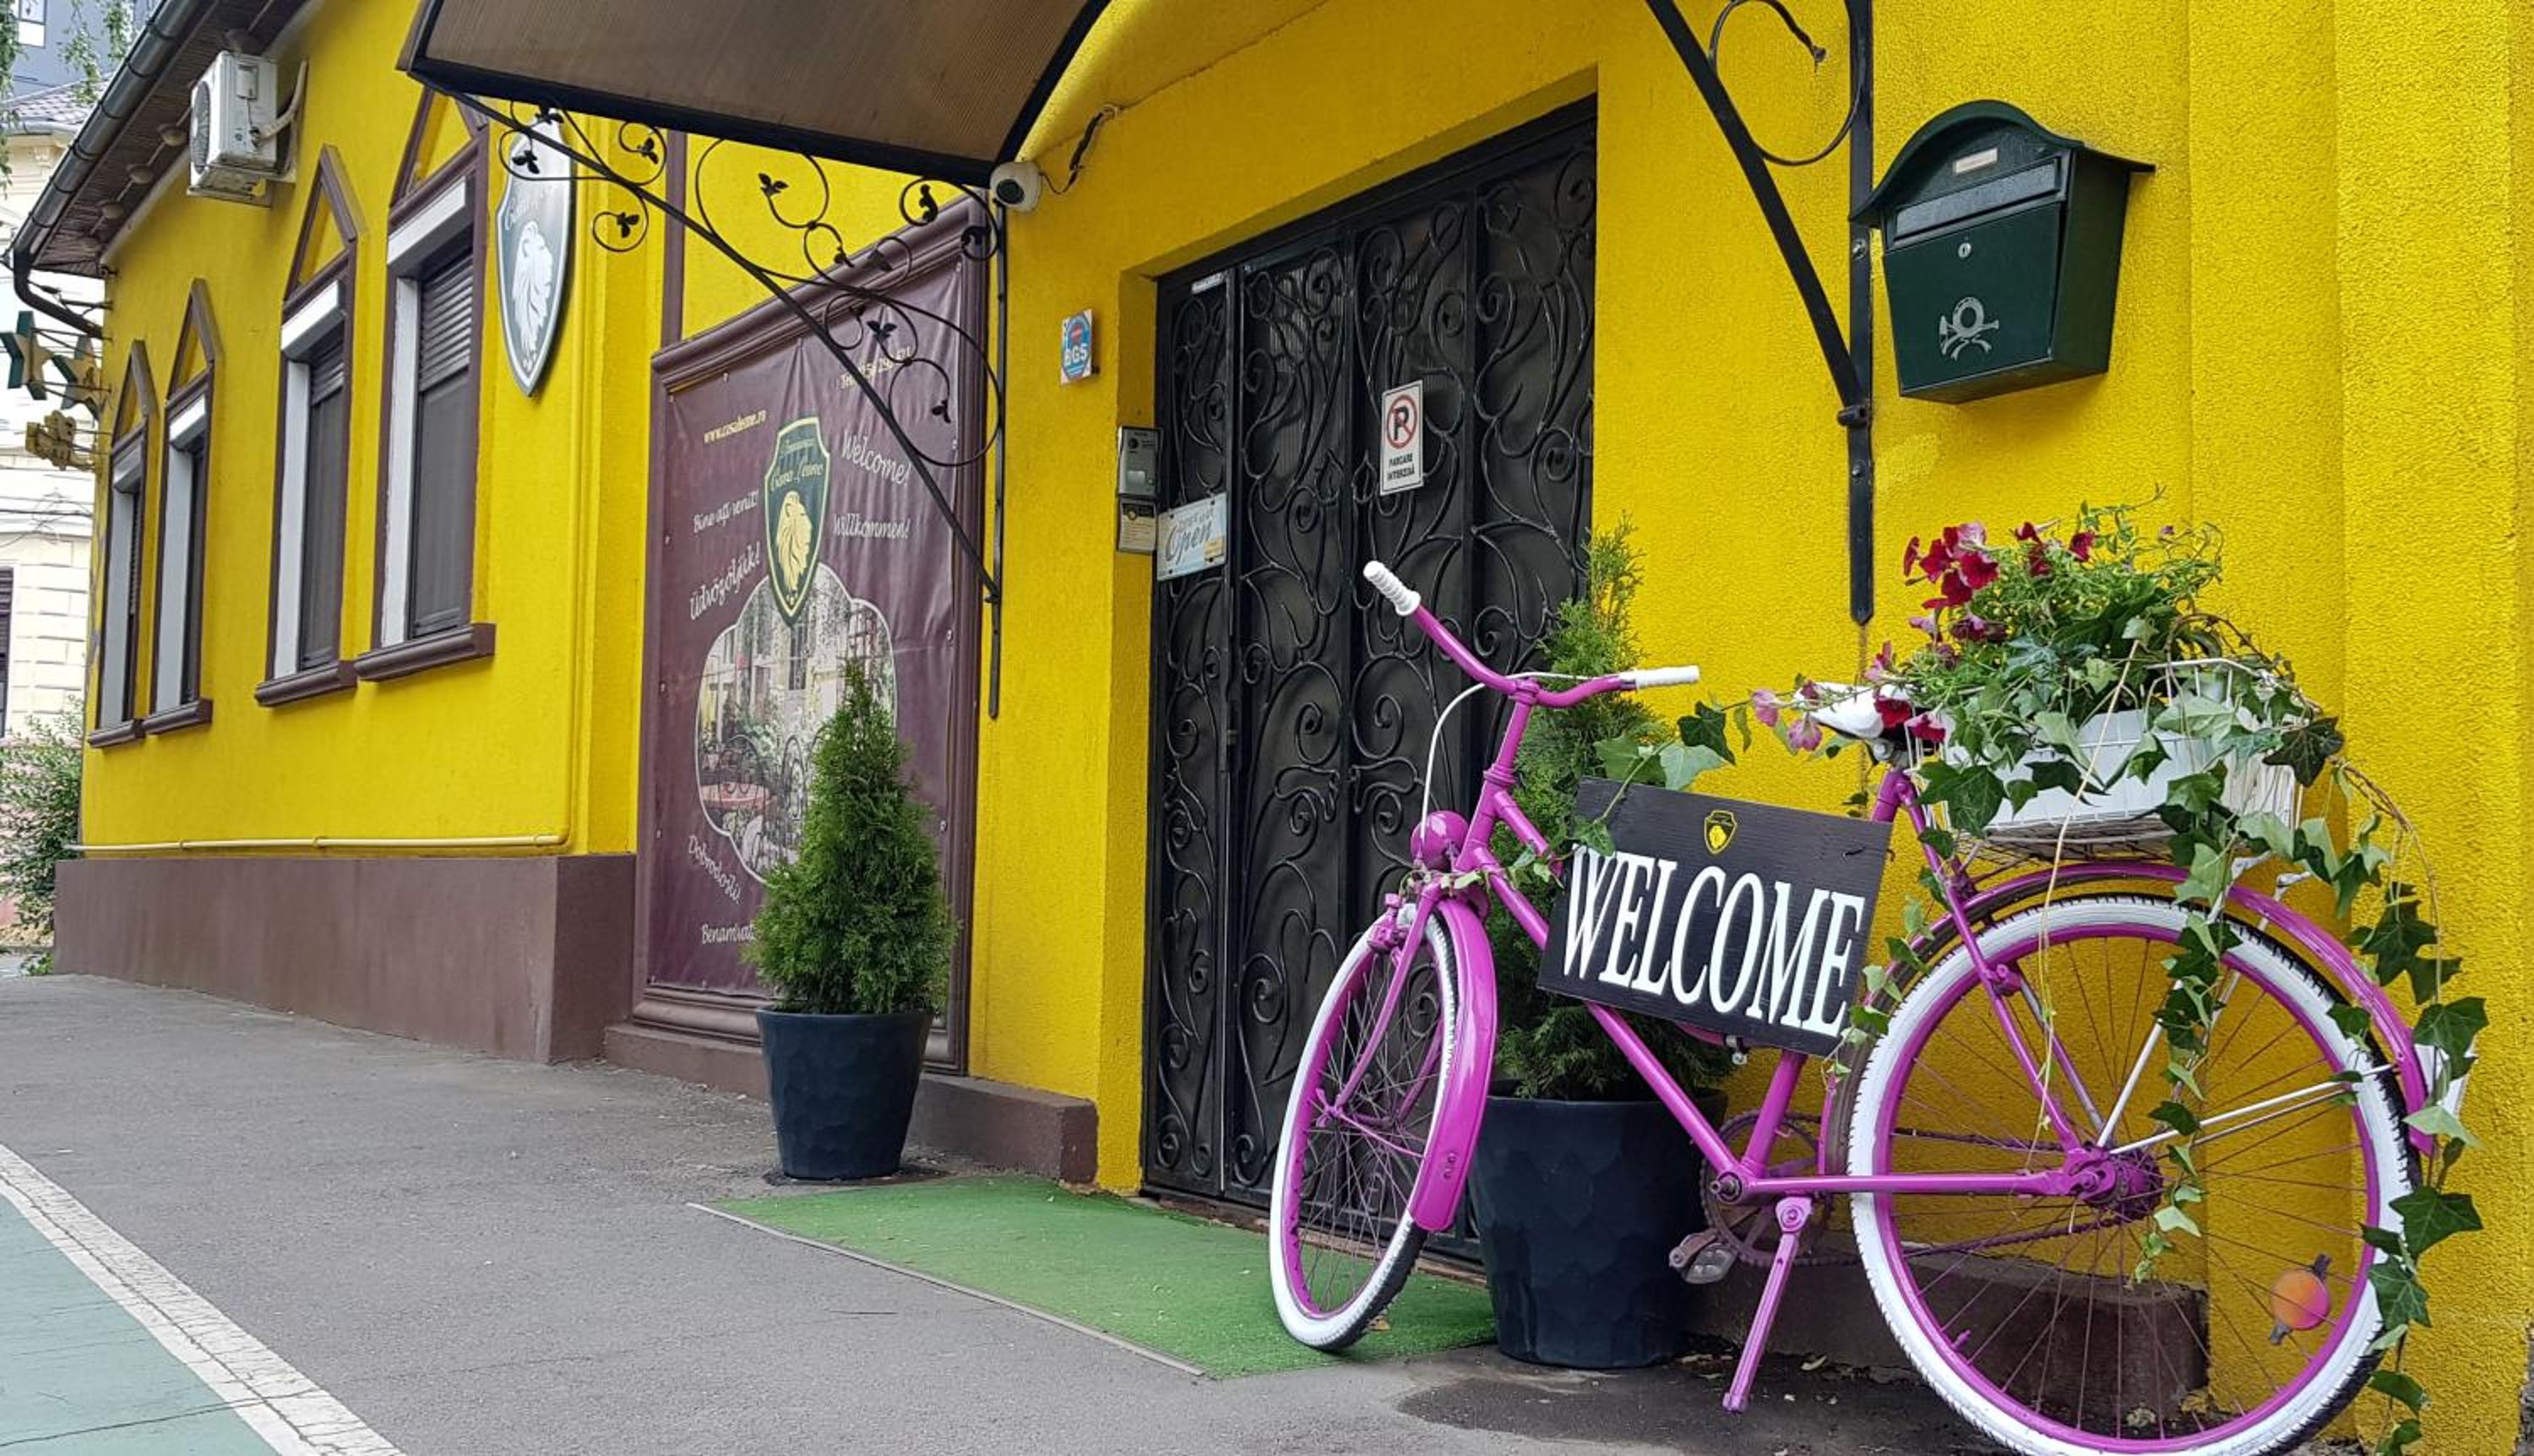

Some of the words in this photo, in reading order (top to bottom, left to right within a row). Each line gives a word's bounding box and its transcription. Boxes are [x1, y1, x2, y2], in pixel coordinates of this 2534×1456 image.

[842, 429, 912, 486] Welcome!
[833, 513, 911, 540] Willkommen!
[1563, 843, 1866, 1037] WELCOME
